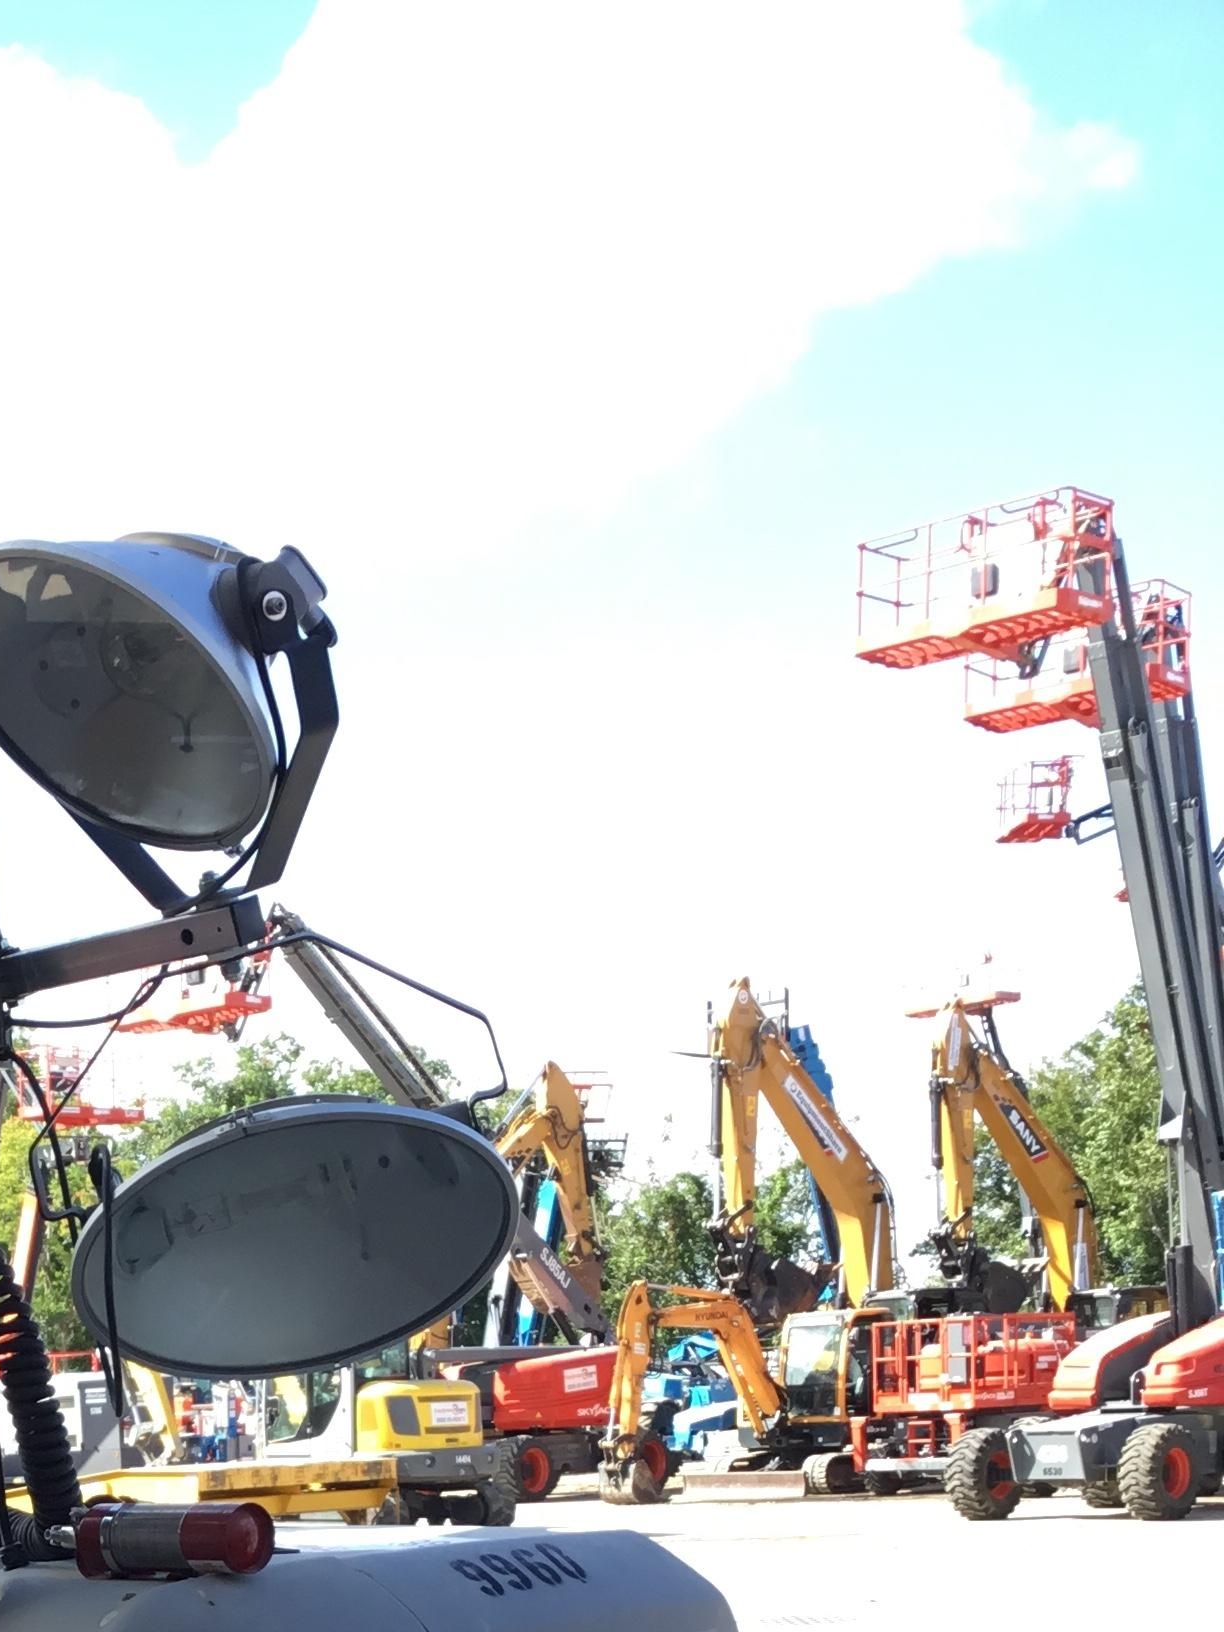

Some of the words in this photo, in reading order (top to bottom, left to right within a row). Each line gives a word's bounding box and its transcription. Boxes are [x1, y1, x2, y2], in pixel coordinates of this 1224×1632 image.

[1009, 1109, 1041, 1153] SANY
[540, 1247, 572, 1288] SJ85AJ
[695, 1311, 729, 1321] HYUNDAI
[449, 1543, 588, 1597] 9960
